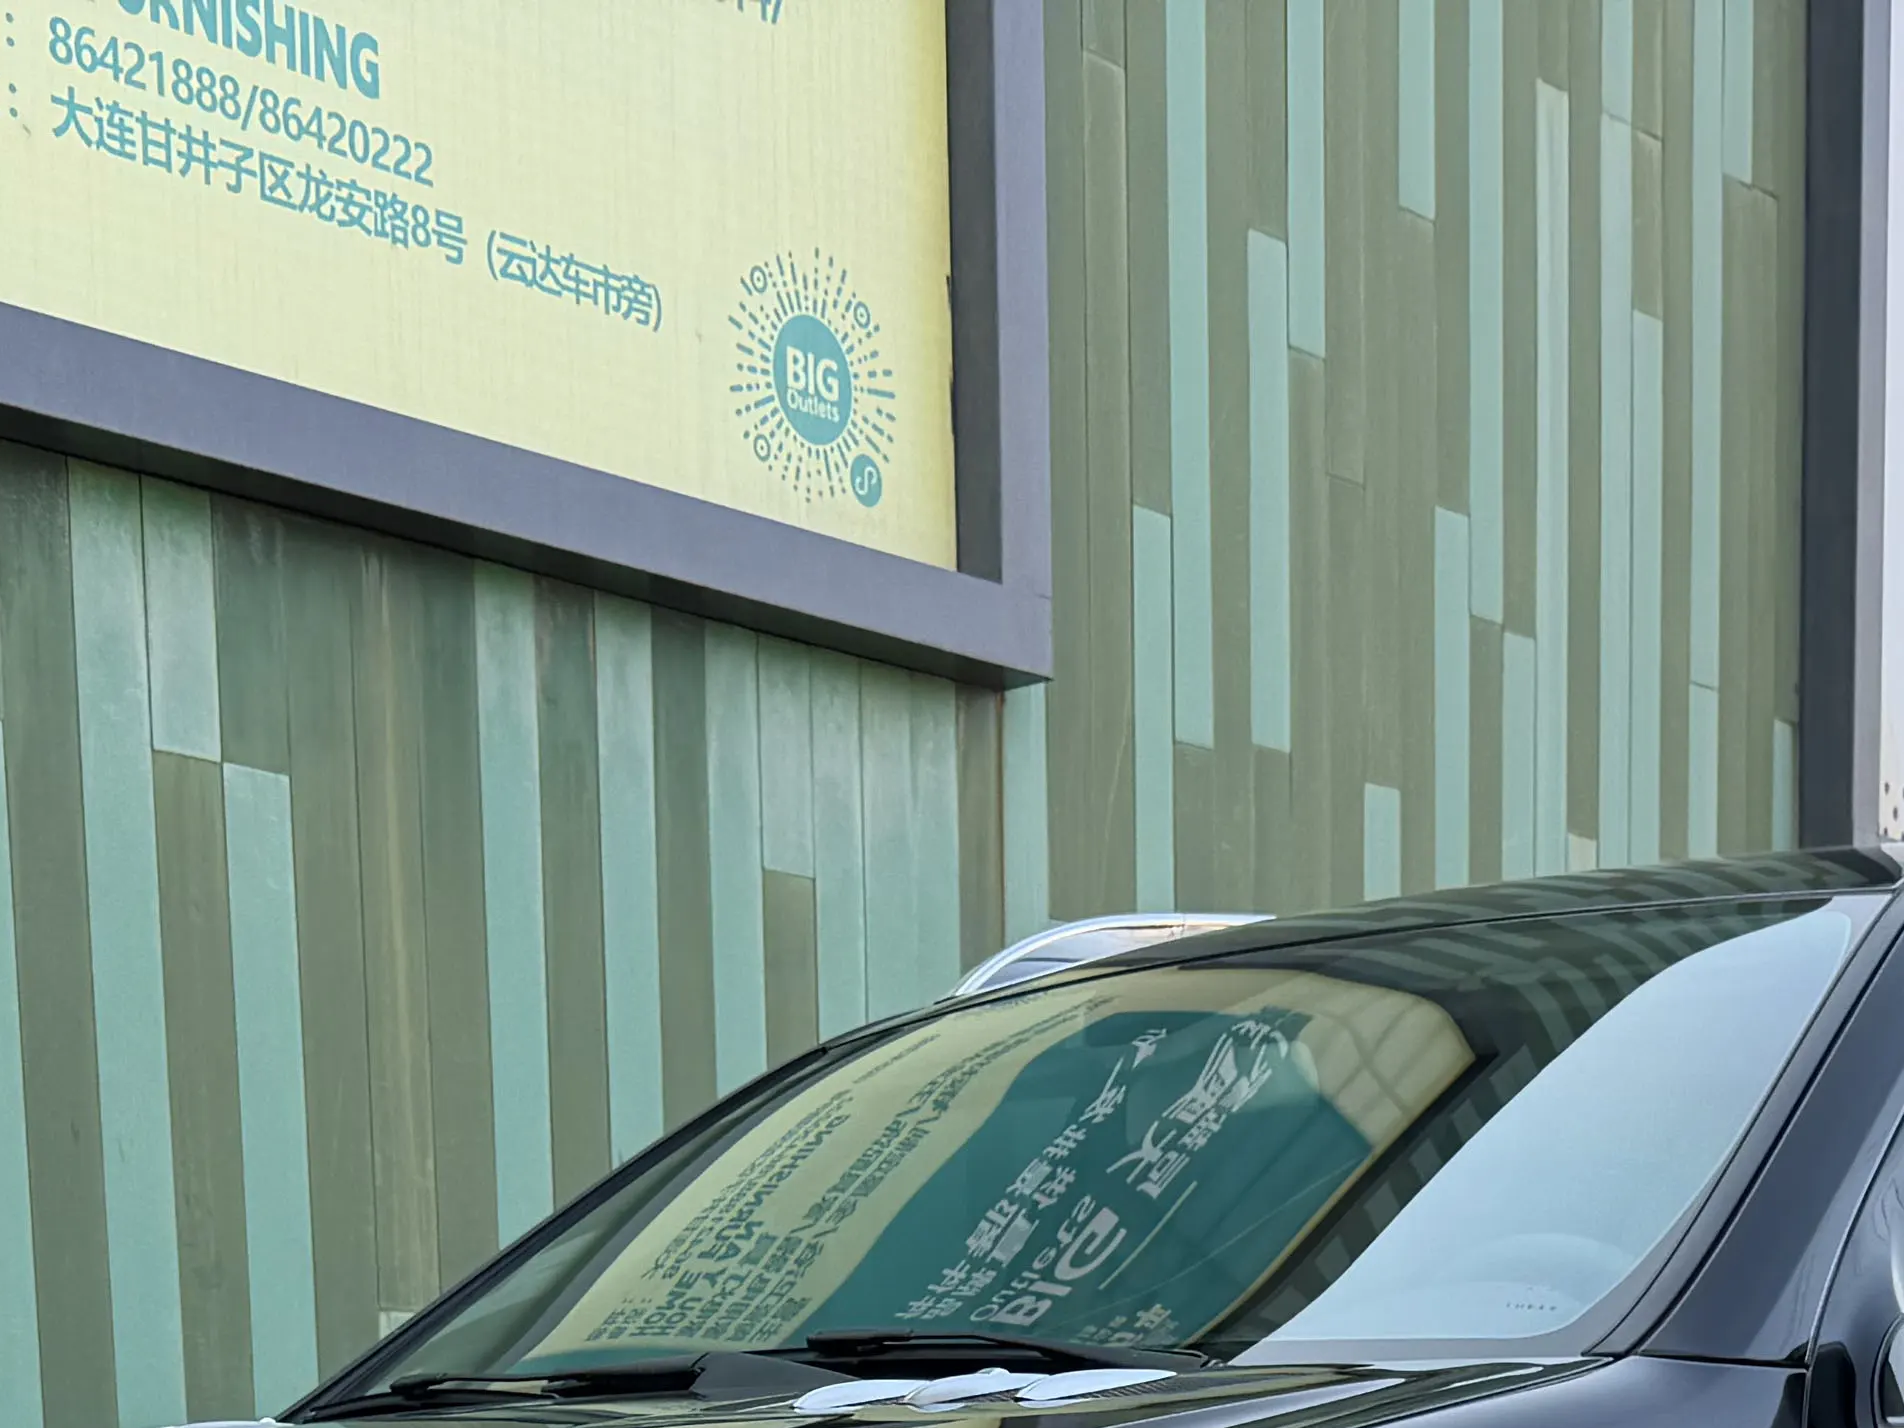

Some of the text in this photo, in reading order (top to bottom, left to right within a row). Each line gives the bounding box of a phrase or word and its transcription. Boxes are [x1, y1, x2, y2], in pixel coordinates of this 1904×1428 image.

[118, 0, 380, 99] NISHING
[49, 16, 434, 187] 86421888/86420222
[786, 345, 840, 402] BIG
[786, 386, 840, 423] Outlets
